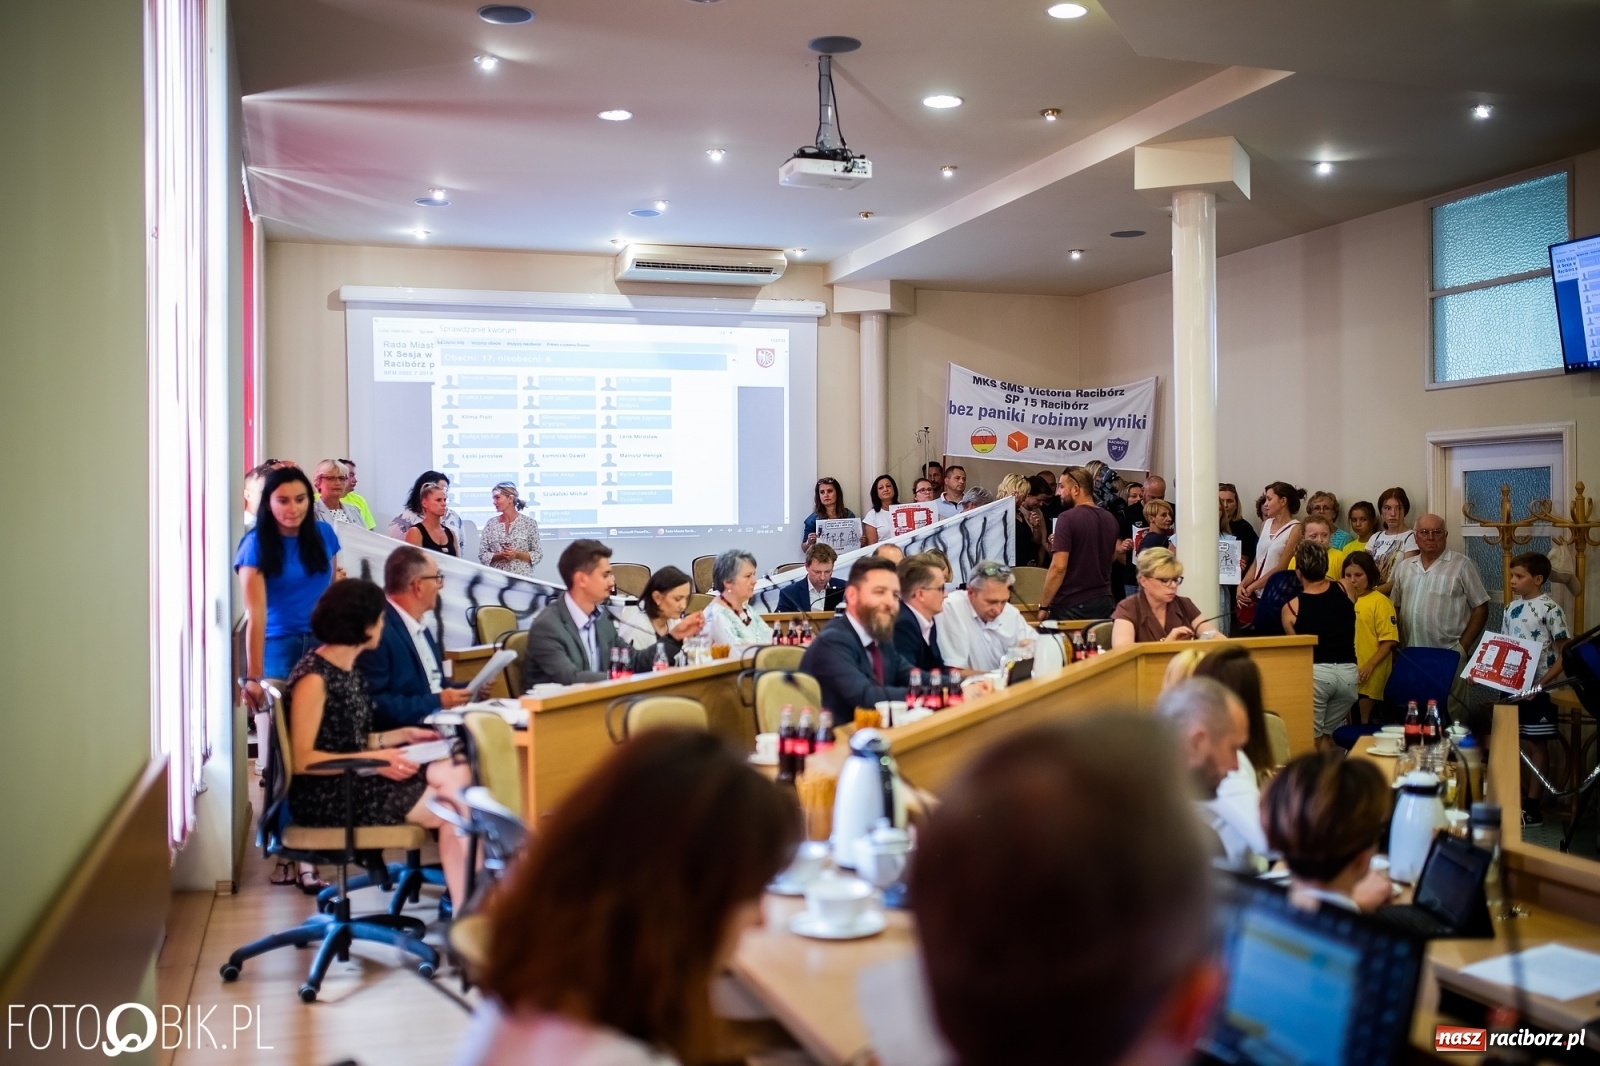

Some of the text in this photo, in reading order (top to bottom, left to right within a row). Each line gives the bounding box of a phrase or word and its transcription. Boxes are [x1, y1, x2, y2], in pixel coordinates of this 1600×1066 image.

[439, 324, 517, 335] Sprawdzanie kworum
[383, 340, 434, 349] Rada Miast
[383, 350, 393, 358] IX
[396, 350, 422, 359] Sesja
[444, 353, 478, 362] Obecni:
[383, 359, 435, 370] Racibórz p
[972, 375, 1126, 399] MKS SMS Victoria Racibórz
[1004, 393, 1090, 411] SP 15 Racibórz
[948, 400, 1147, 432] bez paniki robimy wyniki
[1034, 437, 1093, 452] PAKON
